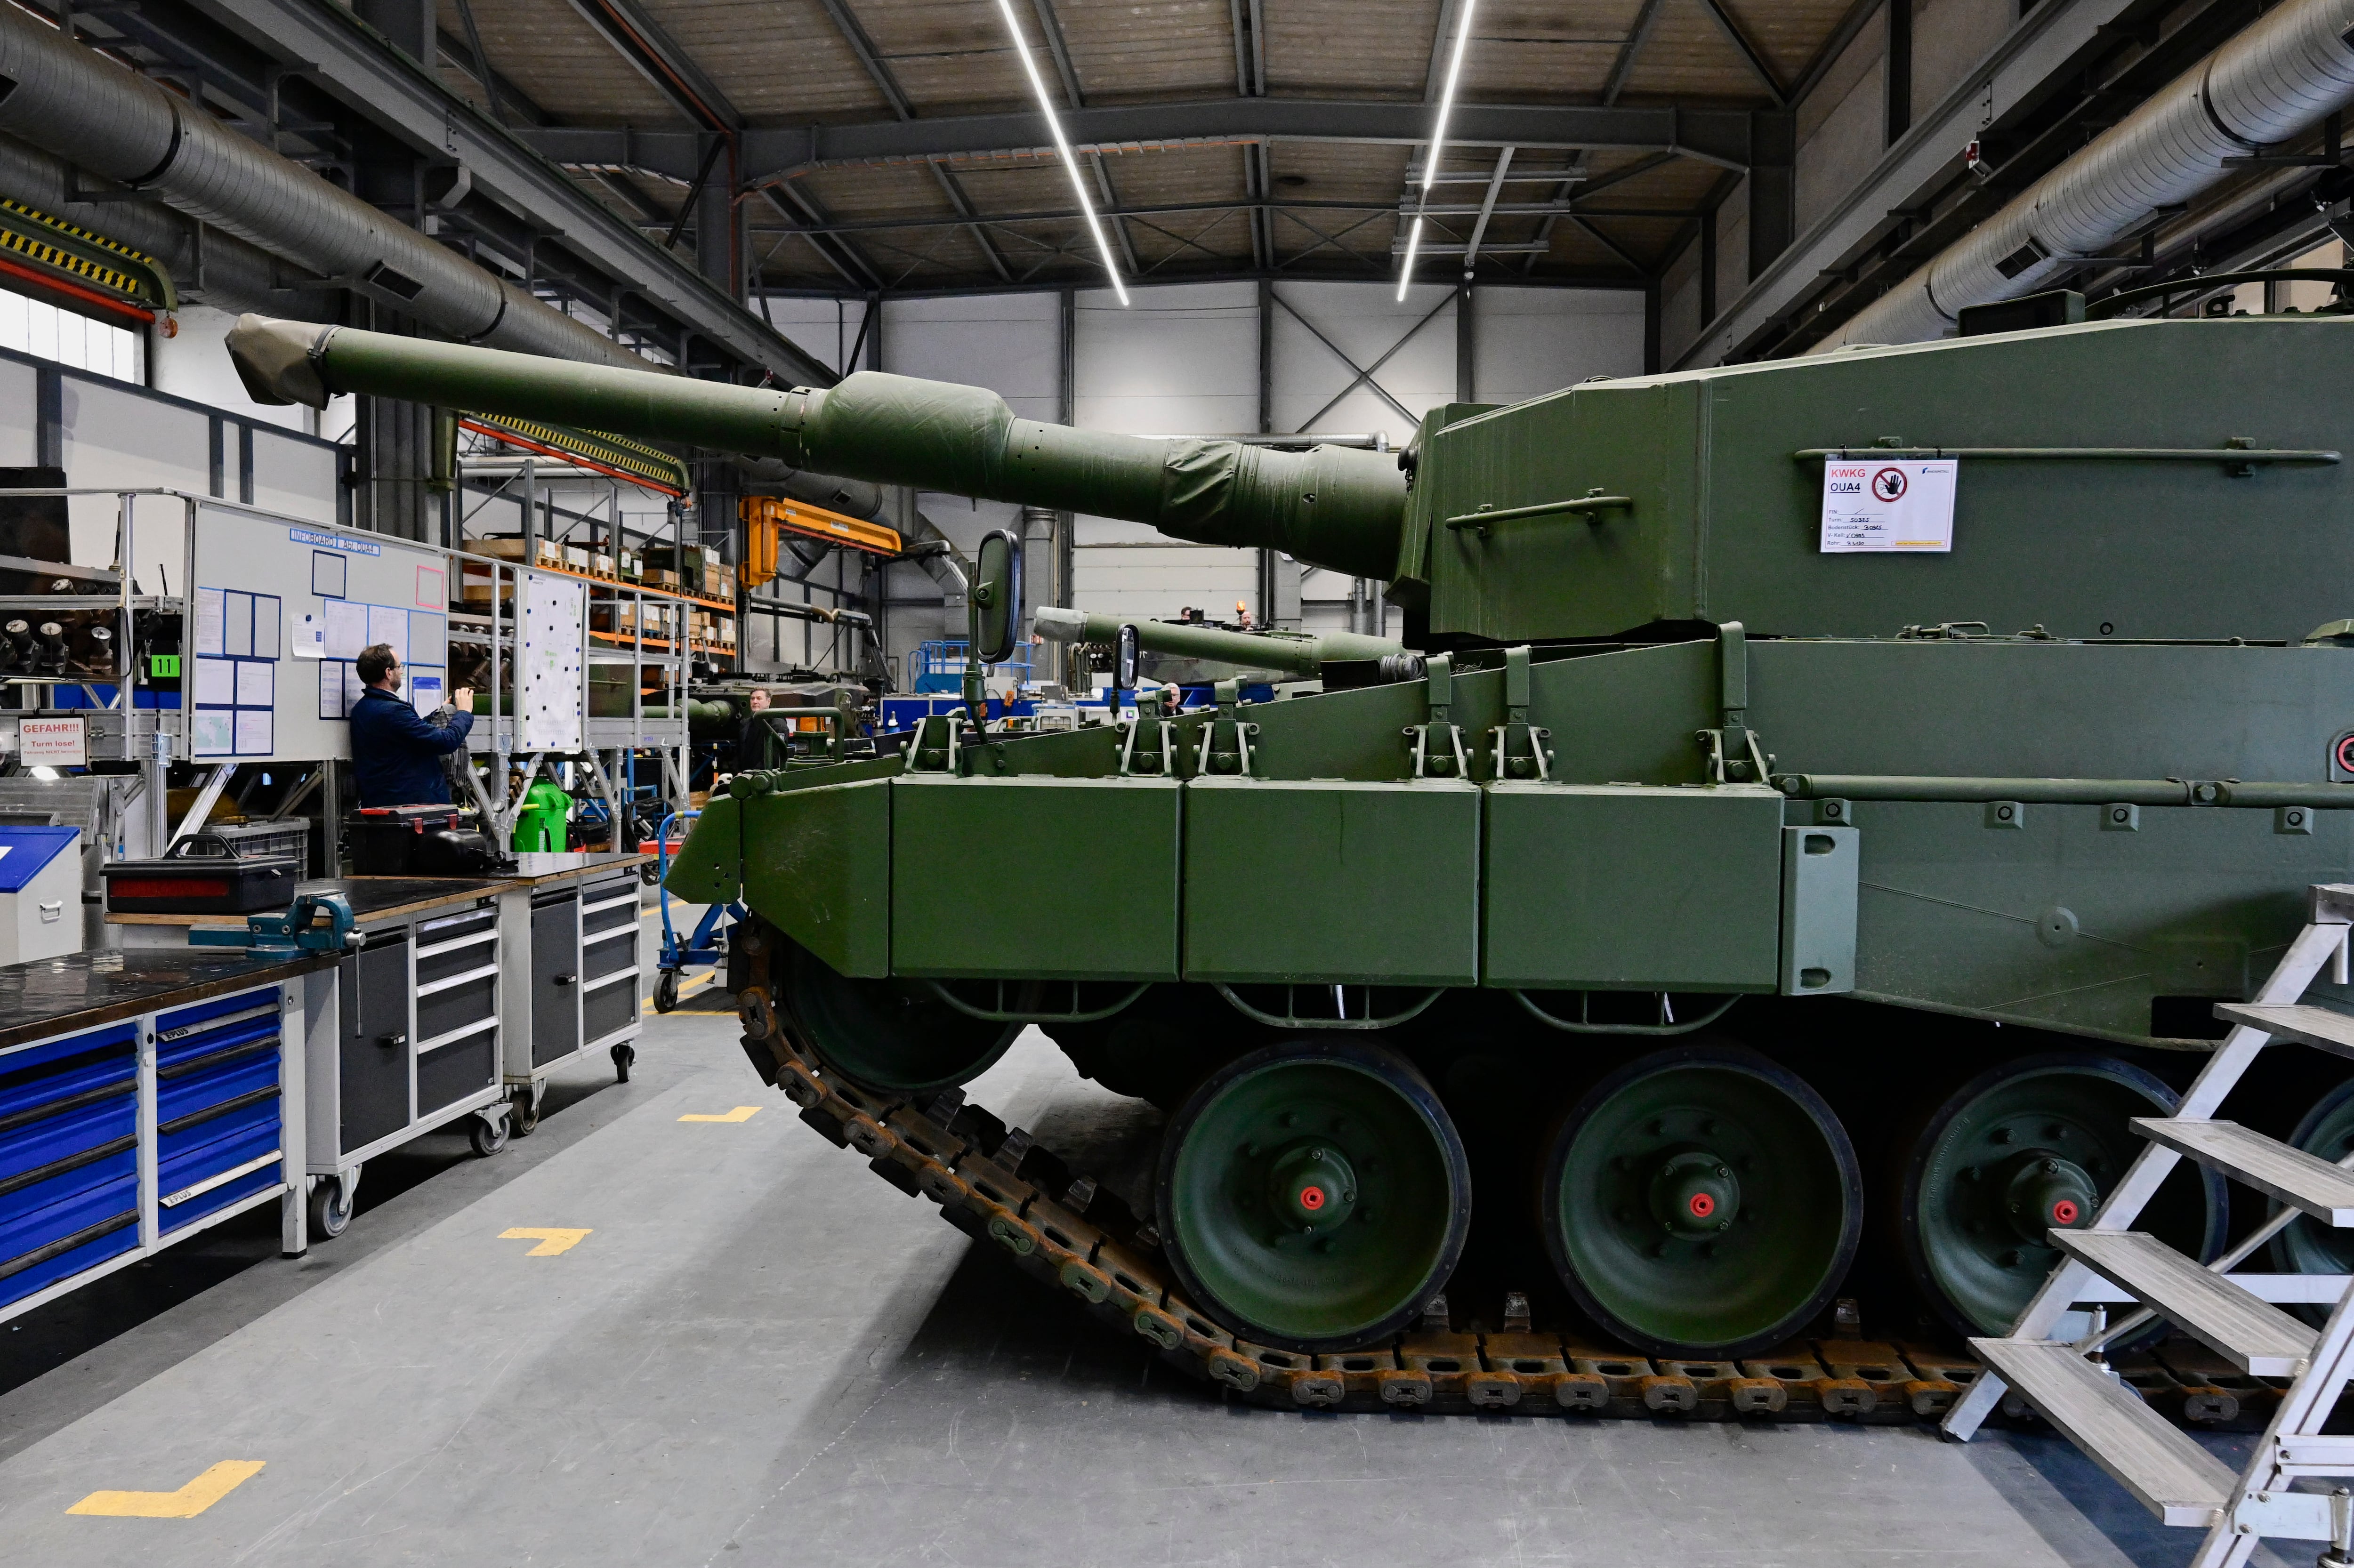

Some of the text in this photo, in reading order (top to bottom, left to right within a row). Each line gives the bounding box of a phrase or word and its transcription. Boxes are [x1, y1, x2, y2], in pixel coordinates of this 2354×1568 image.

[1831, 469, 1865, 477] KWKG
[1830, 482, 1861, 491] OUA4
[294, 531, 373, 553] INFOBOARD Abt. OUA4
[158, 659, 170, 673] 11
[23, 724, 79, 732] GEFAHR!!!
[167, 1028, 189, 1039] E-PLUS
[168, 1190, 192, 1204] E-PLUS
